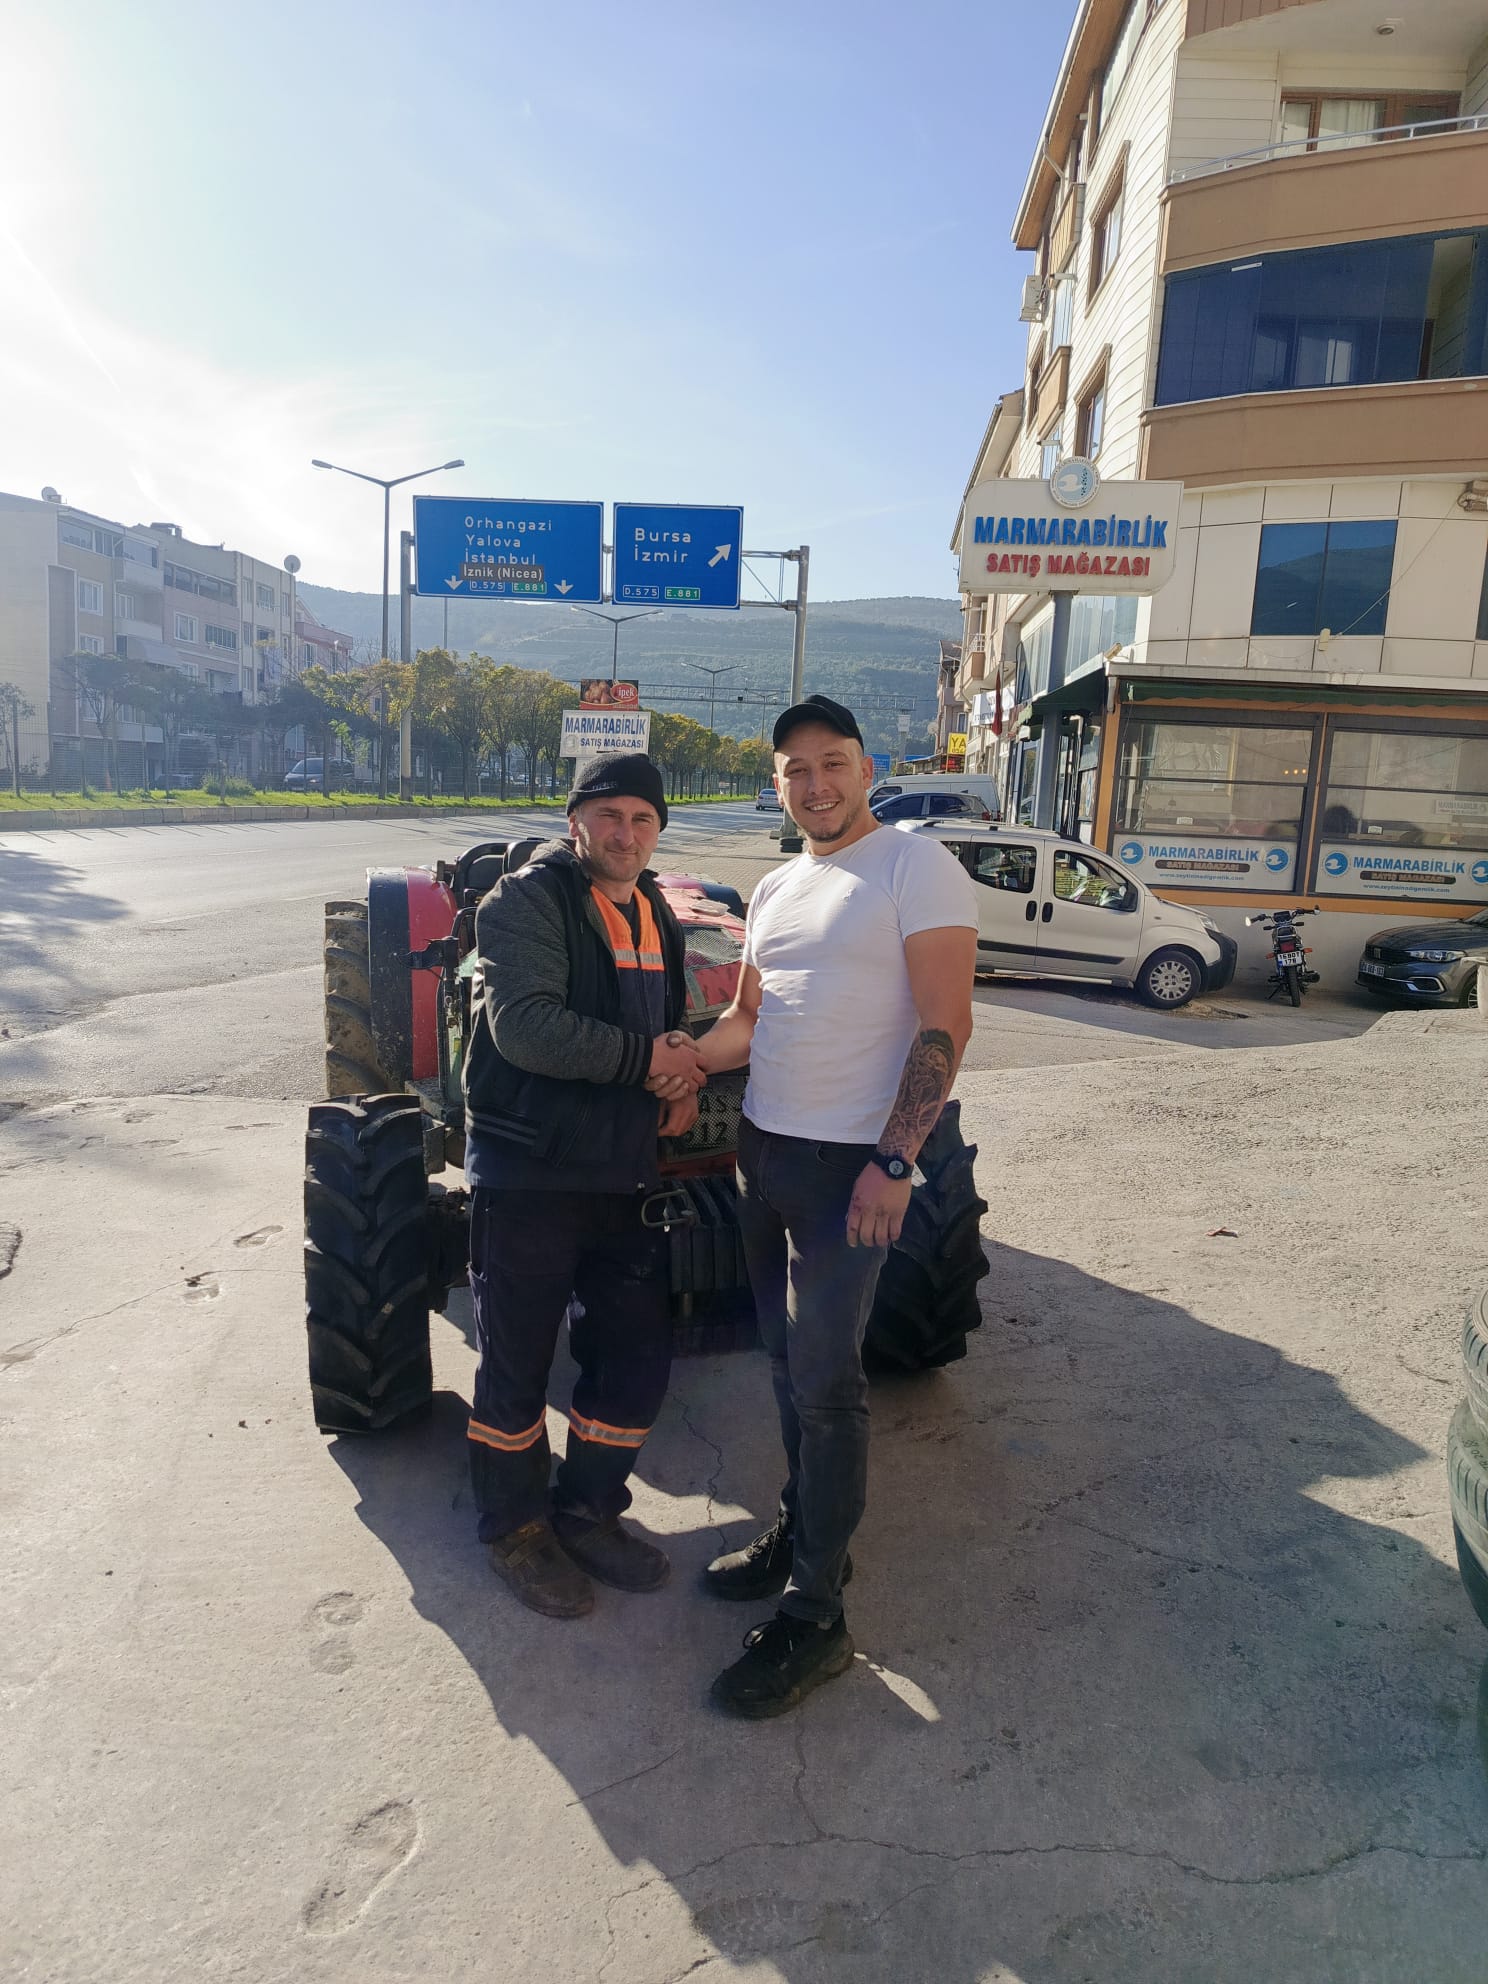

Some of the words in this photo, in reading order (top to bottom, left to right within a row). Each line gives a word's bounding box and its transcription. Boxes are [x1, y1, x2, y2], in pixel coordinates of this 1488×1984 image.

[464, 516, 552, 533] Orhangazi
[974, 514, 1168, 548] MARMARABİRLİK
[465, 534, 521, 548] Yalova
[634, 527, 691, 543] Bursa
[465, 548, 536, 565] İstanbul
[634, 544, 688, 563] İzmir
[986, 553, 1041, 577] SATIŞ
[1047, 552, 1151, 576] MAĞAZASI
[497, 567, 543, 581] (Nicea)
[513, 582, 545, 591] E.881
[624, 587, 658, 597] D.575
[666, 589, 698, 598] E.881
[565, 714, 647, 735] MARMARABİRLİK
[580, 738, 602, 749] SATIŞ
[603, 737, 644, 748] MAĞAZASI
[1149, 846, 1259, 862] MARMARABİRLİK
[1353, 856, 1465, 874] MARMARABİRLİK
